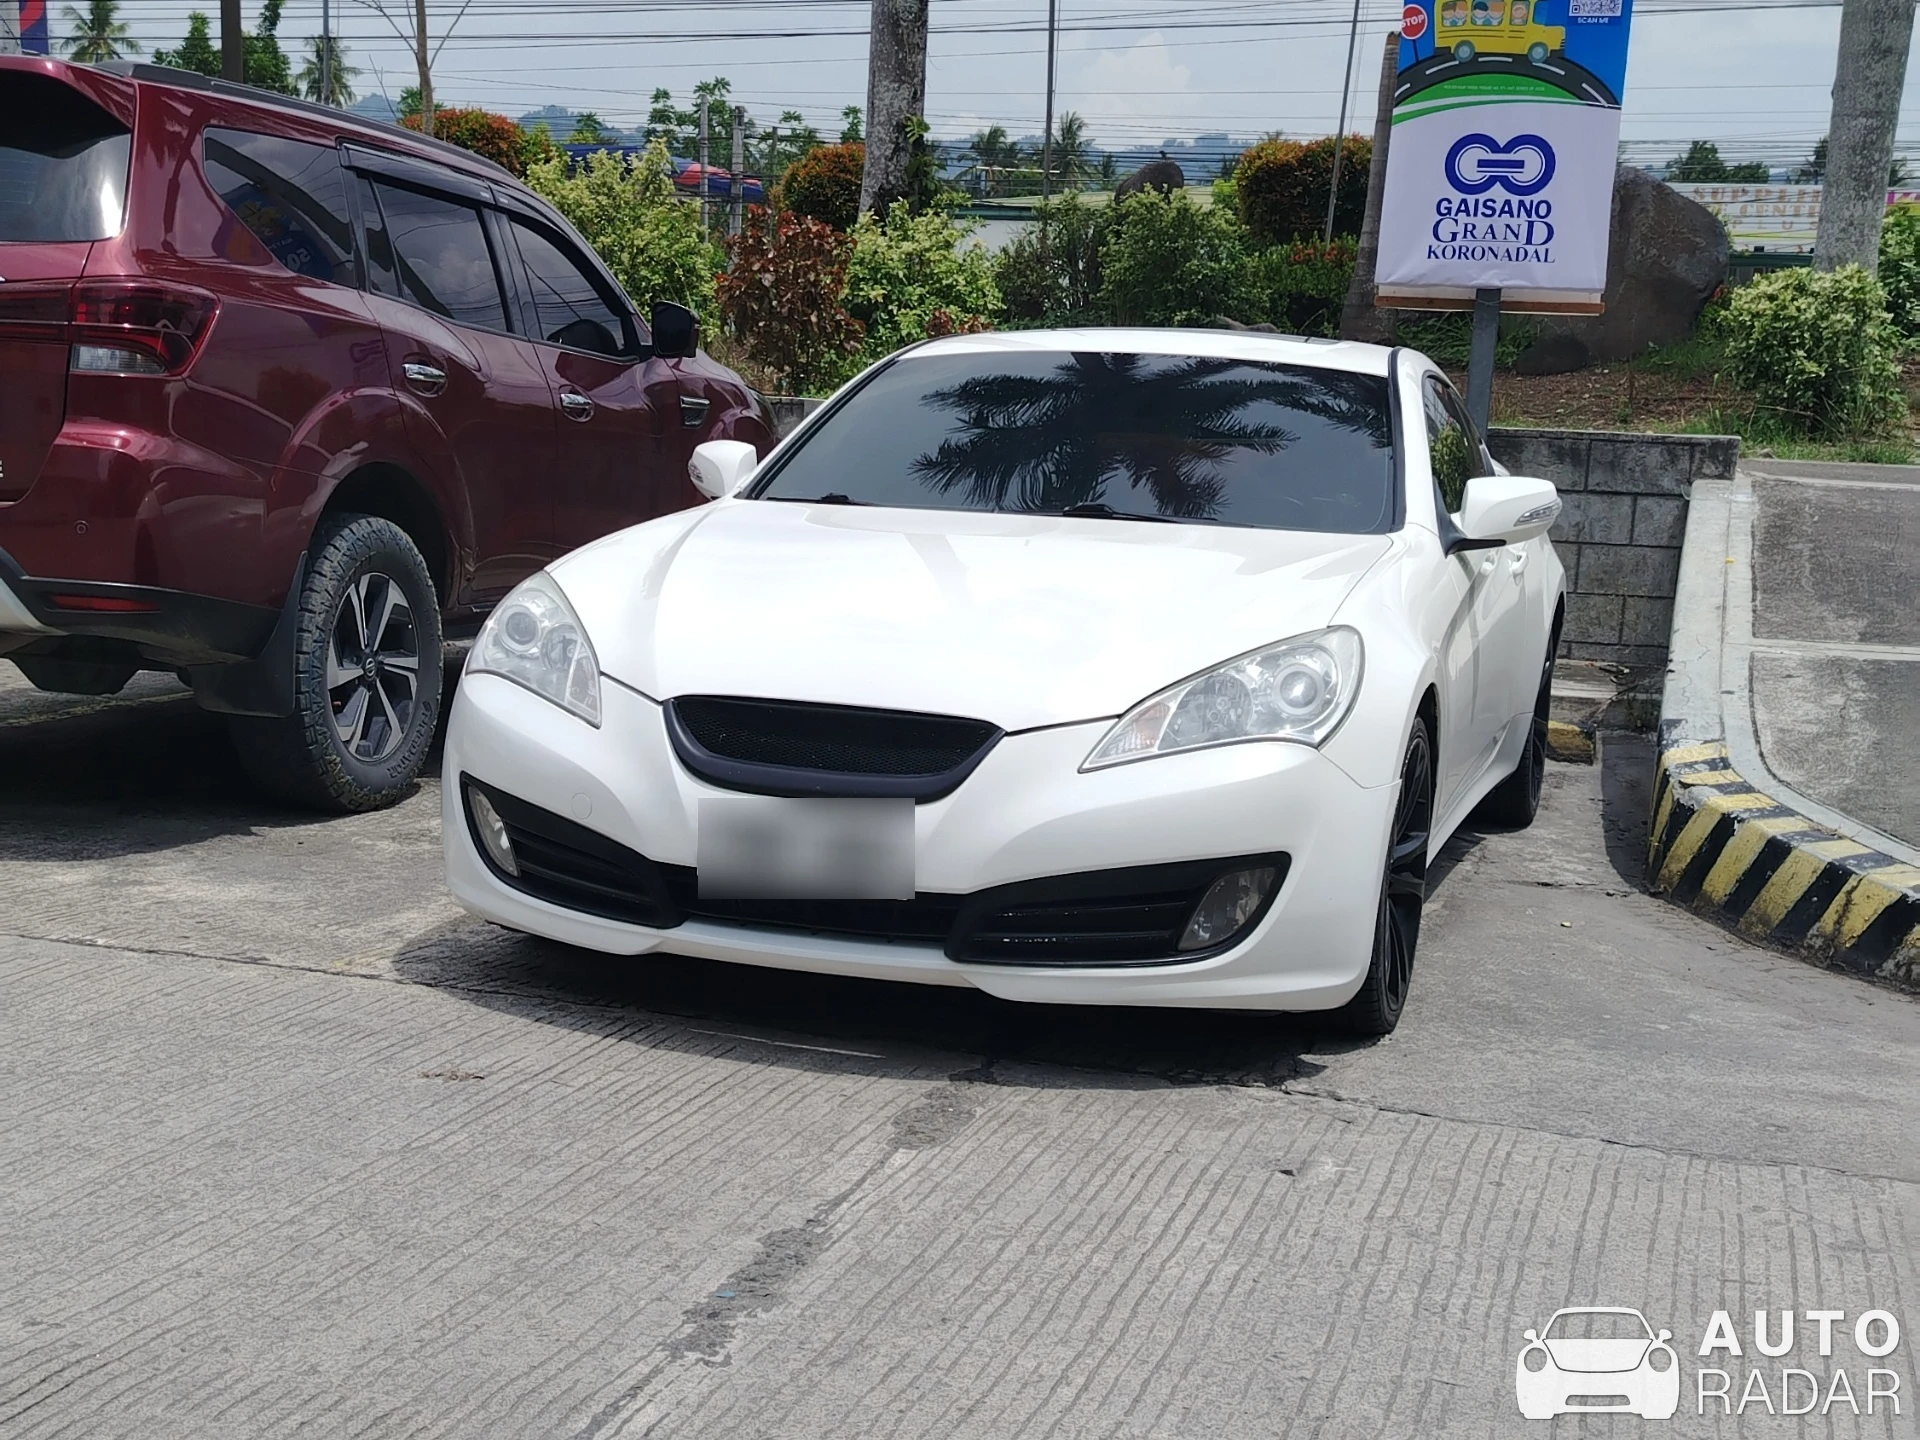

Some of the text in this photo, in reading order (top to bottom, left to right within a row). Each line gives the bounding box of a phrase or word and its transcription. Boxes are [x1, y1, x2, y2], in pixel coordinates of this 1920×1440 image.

[1402, 14, 1424, 28] STOP
[1435, 198, 1552, 219] GAISANO
[1432, 217, 1554, 246] GRAND
[1427, 245, 1555, 263] KORONADAL
